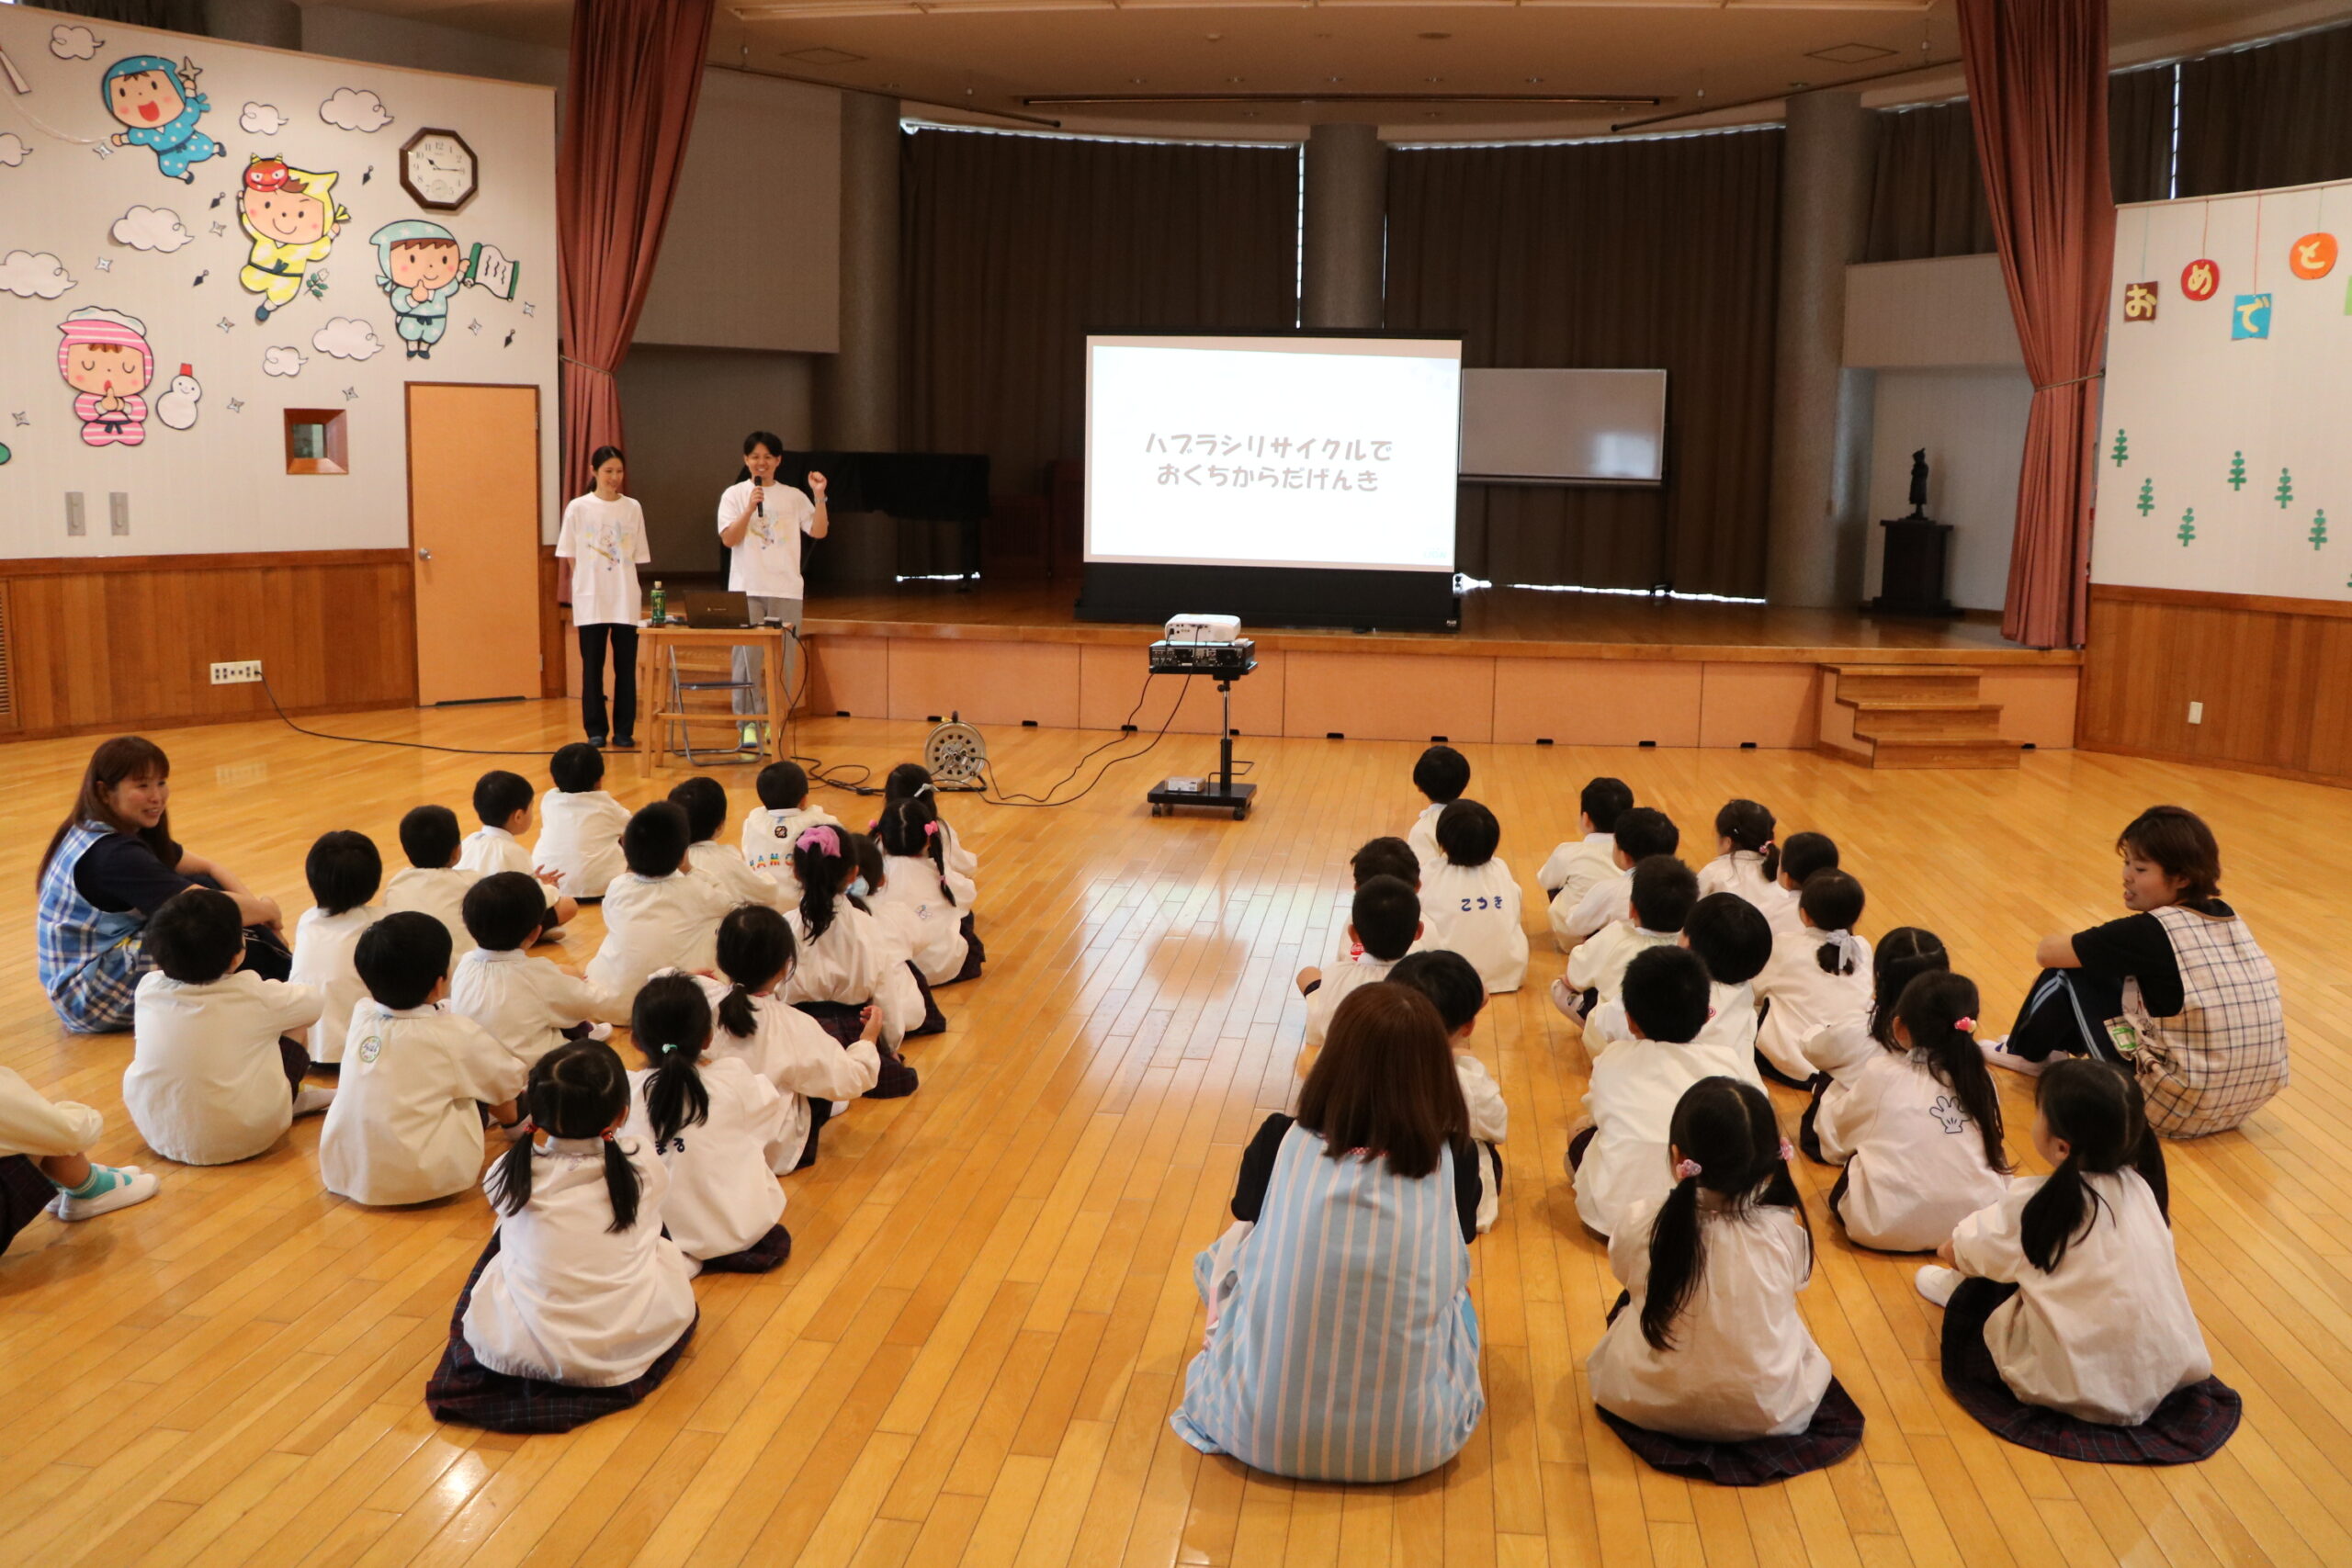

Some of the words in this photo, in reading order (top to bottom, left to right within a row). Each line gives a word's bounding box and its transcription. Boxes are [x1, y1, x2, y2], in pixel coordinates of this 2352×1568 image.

[2125, 284, 2157, 318] お
[2188, 264, 2212, 295] め
[2236, 296, 2270, 333] で
[2299, 241, 2326, 270] と
[1145, 433, 1393, 462] ハブラシリサイクルで
[1157, 463, 1378, 492] おくちからだげんき
